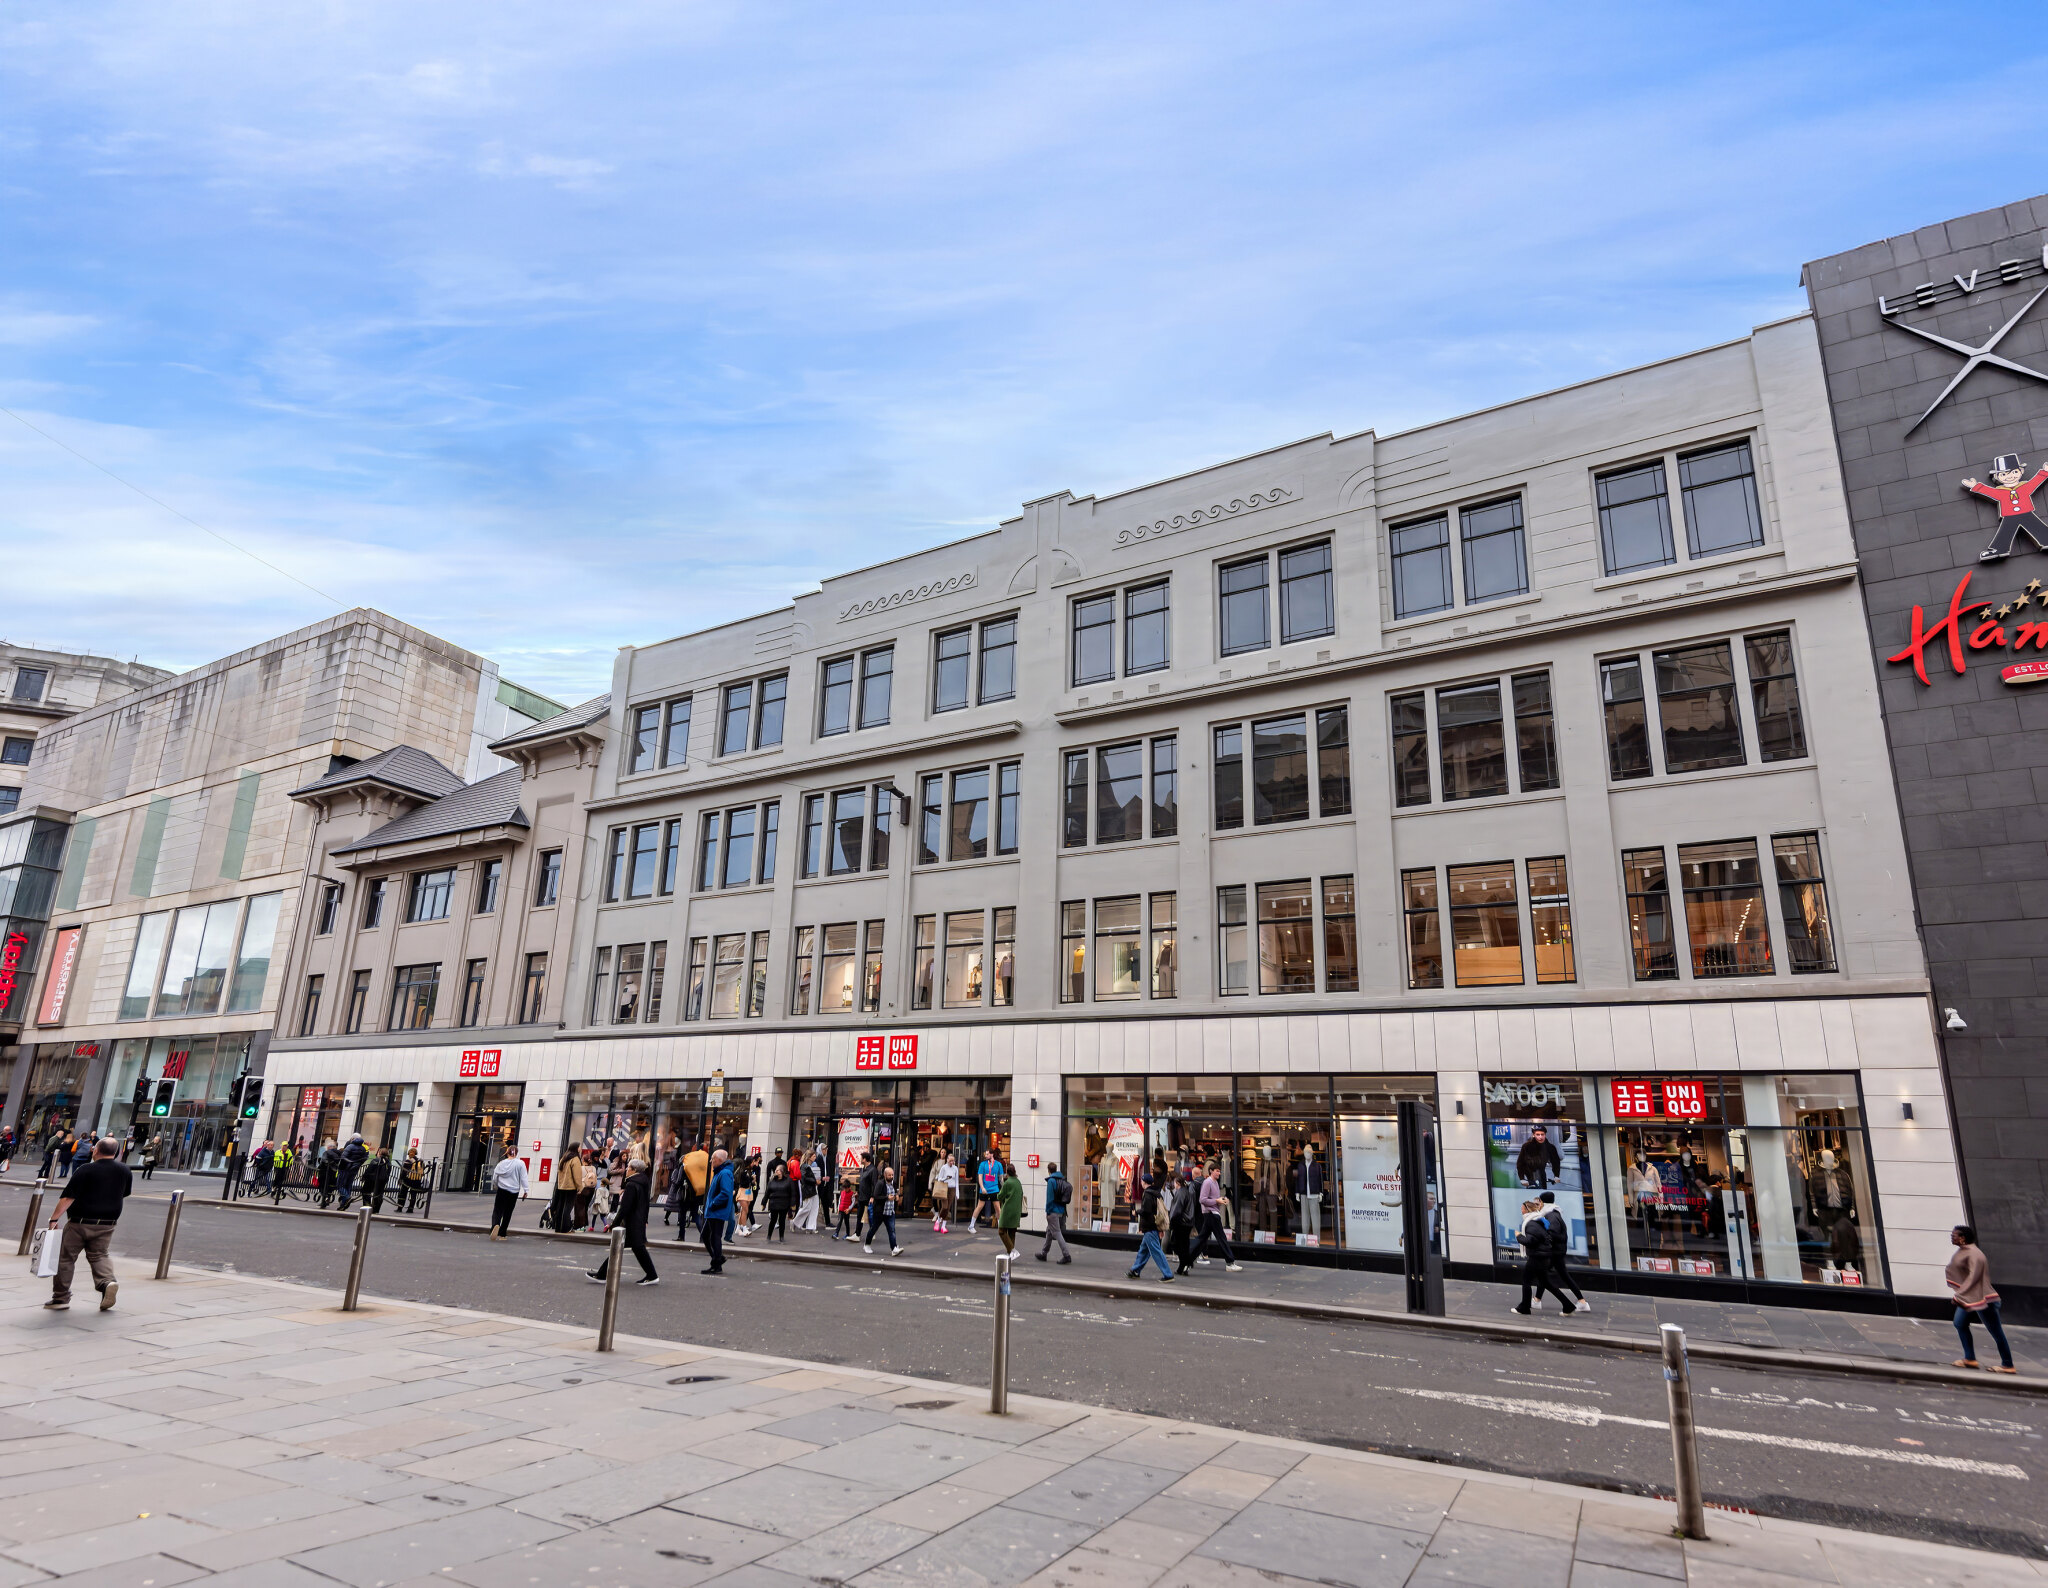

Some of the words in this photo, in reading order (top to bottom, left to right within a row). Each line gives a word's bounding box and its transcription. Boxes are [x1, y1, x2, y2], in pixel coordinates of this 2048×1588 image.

[2014, 664, 2037, 674] EST.
[861, 1039, 880, 1052] ユニ
[892, 1038, 912, 1051] UNI
[483, 1051, 498, 1062] UNI
[858, 1053, 880, 1066] クロ
[891, 1052, 913, 1067] QLO
[482, 1062, 497, 1074] QLO
[1617, 1085, 1647, 1098] ユニ
[1665, 1085, 1697, 1099] UNI
[1618, 1100, 1650, 1113] クロ
[1667, 1100, 1702, 1116] QLO
[1362, 1183, 1389, 1191] ARGYLE
